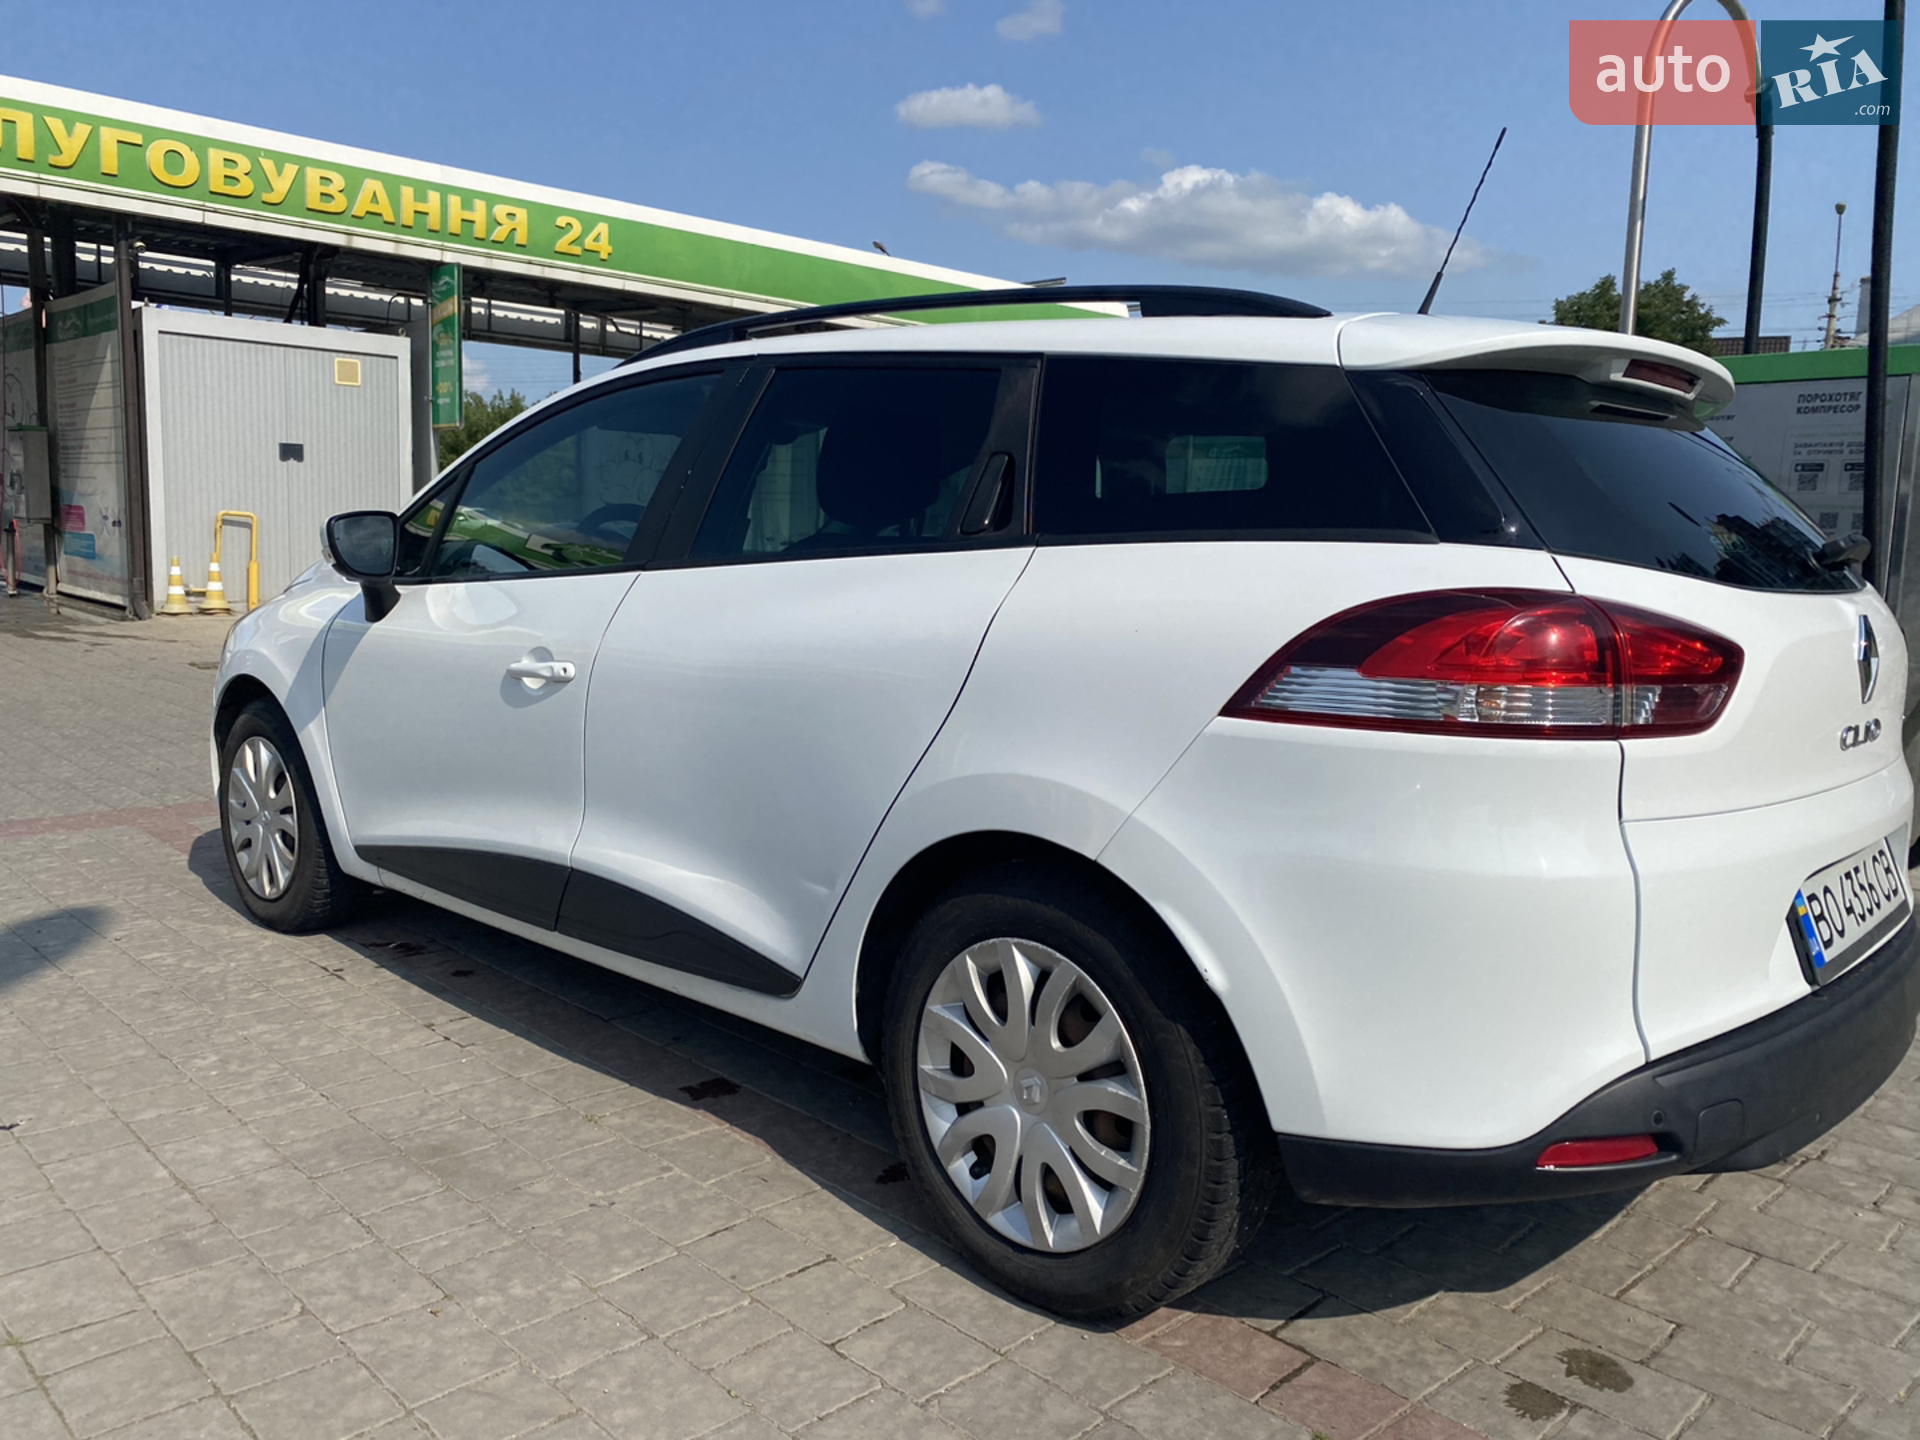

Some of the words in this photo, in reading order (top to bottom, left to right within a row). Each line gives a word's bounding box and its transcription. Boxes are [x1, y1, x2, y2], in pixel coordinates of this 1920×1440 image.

[554, 215, 613, 262] 24
[1796, 404, 1861, 415] КОМПРЕСОР
[1797, 391, 1863, 404] ПОРОХОТЯГ
[1839, 717, 1882, 752] CLIO
